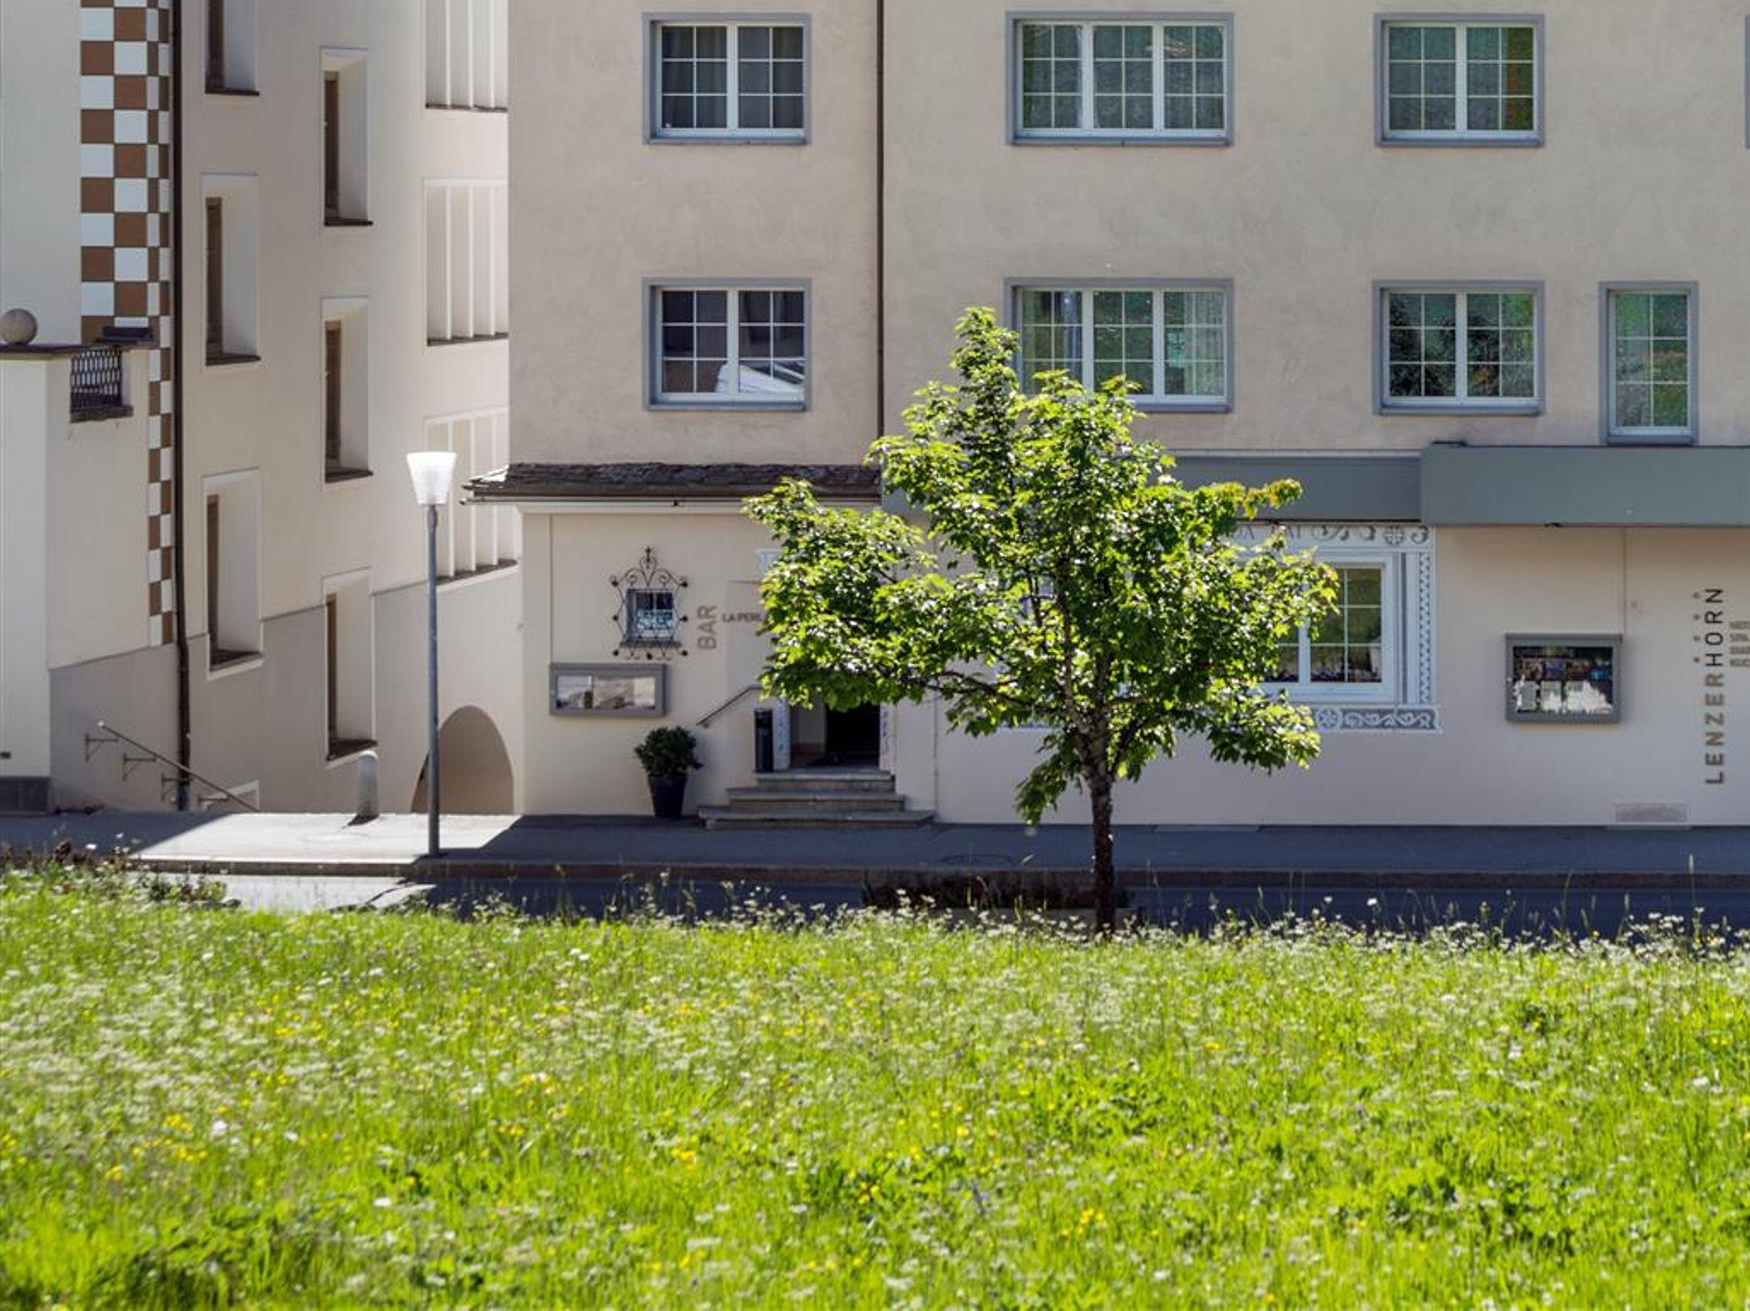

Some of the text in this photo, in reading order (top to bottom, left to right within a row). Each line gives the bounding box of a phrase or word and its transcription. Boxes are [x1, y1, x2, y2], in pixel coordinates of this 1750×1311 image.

[697, 605, 717, 650] BAR
[722, 612, 736, 623] LA
[1704, 588, 1724, 784] LENZERHORN
